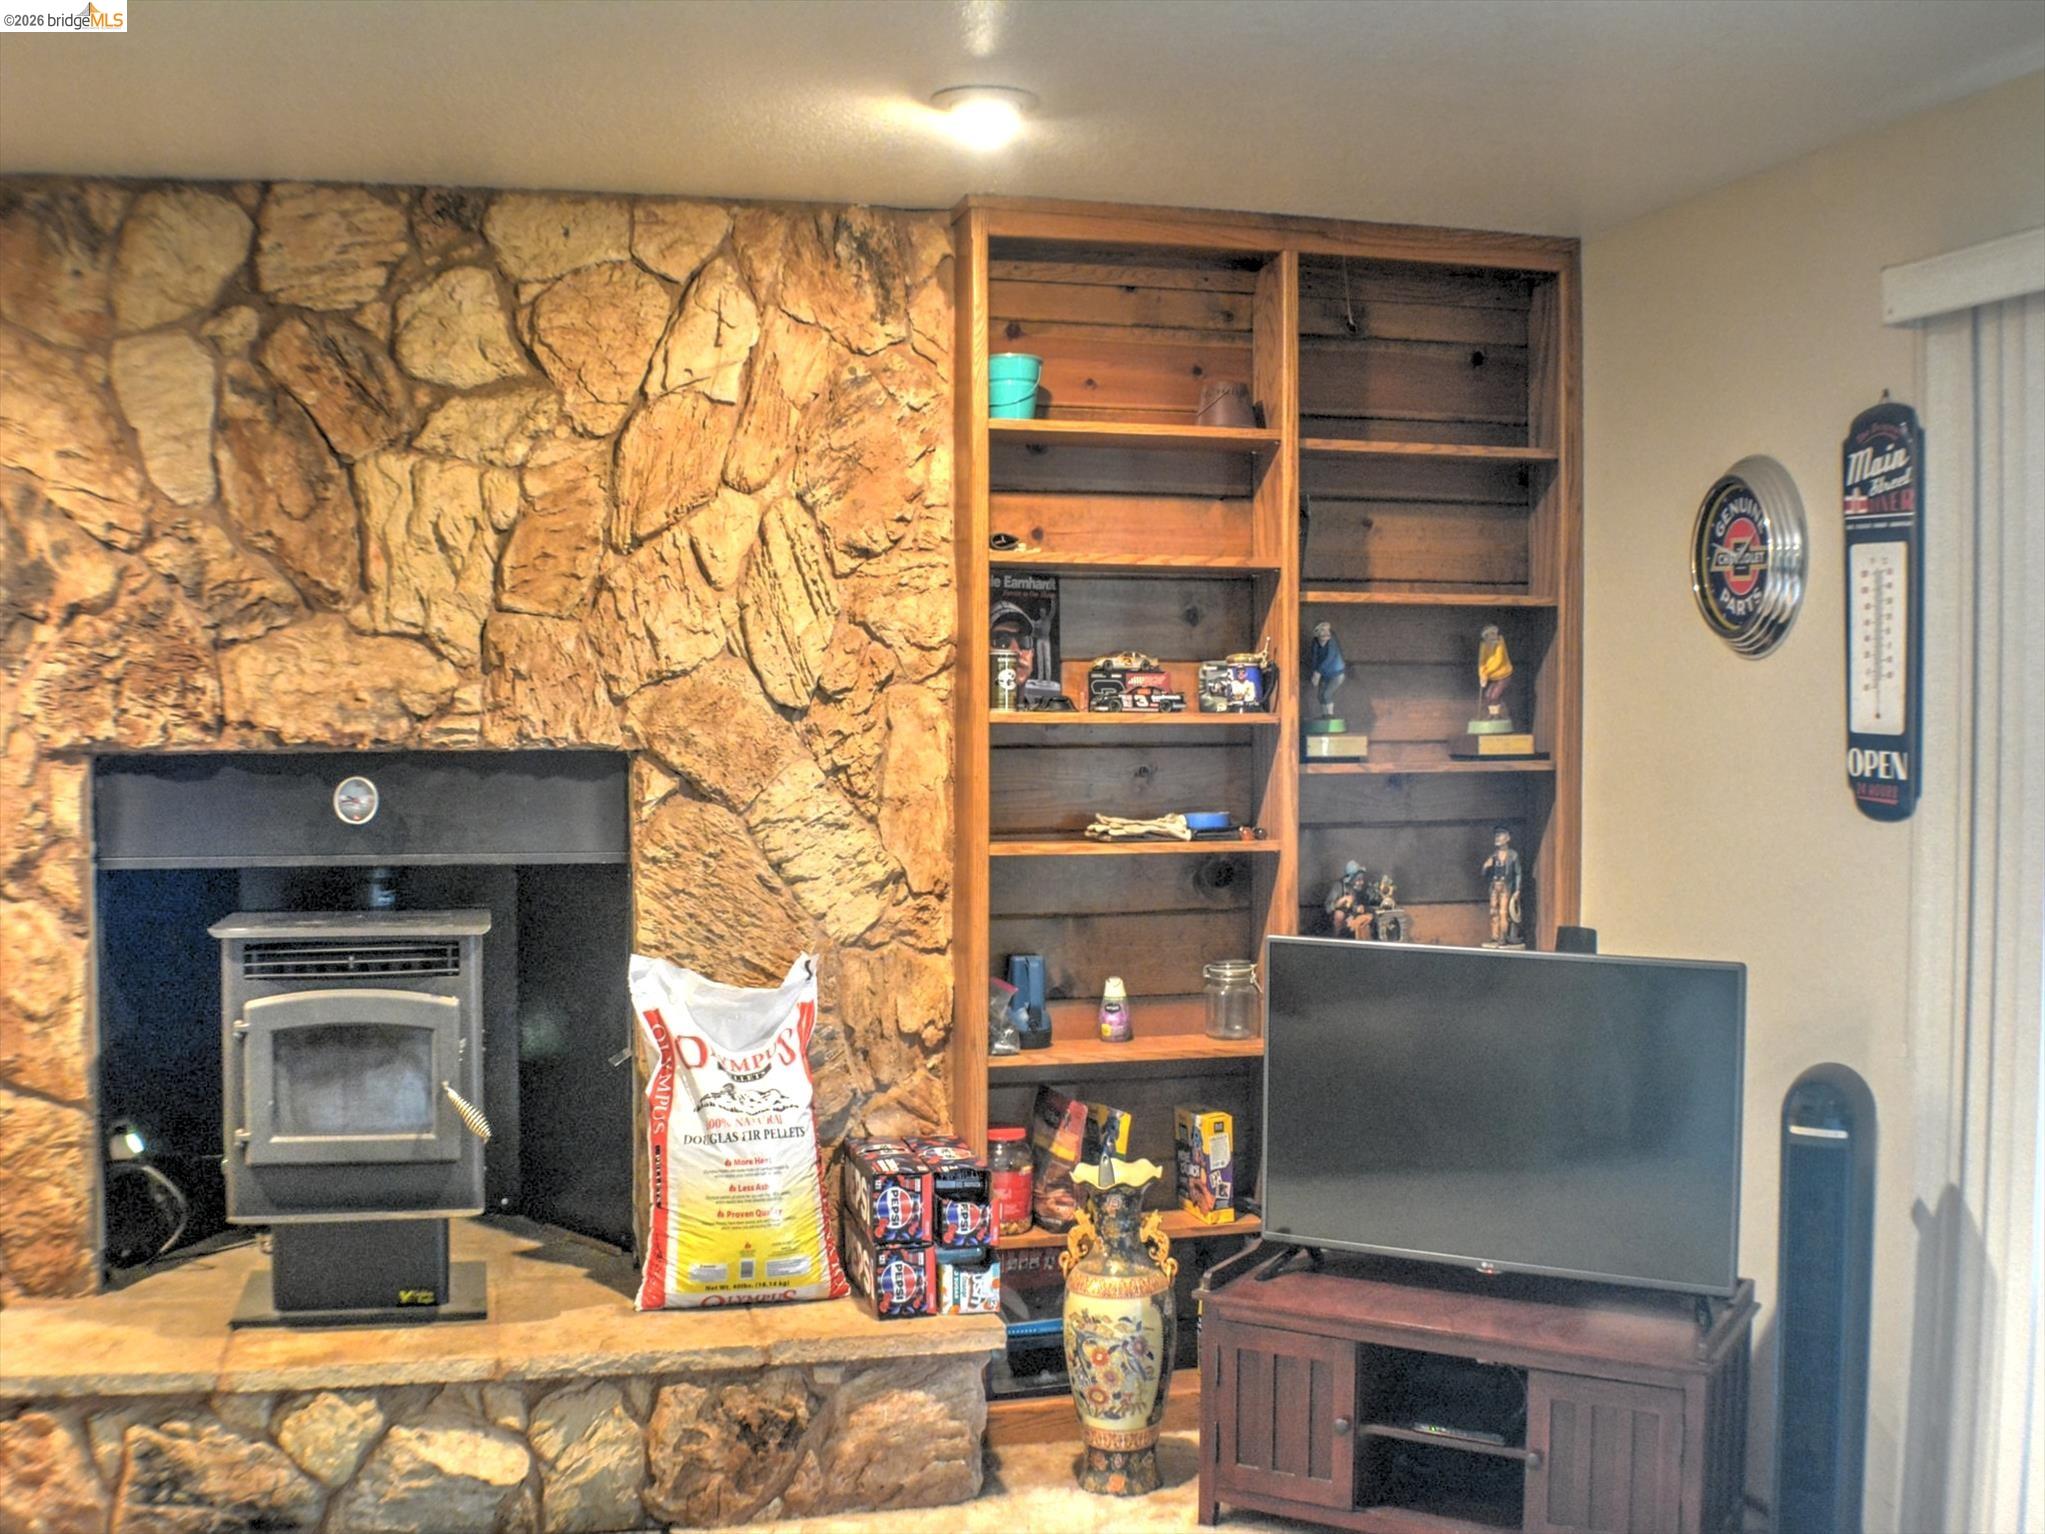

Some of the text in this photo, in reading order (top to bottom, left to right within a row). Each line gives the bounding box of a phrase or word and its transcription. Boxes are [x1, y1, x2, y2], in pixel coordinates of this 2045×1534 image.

[1846, 443, 1911, 487] Main
[1715, 498, 1765, 537] GENUINE
[1720, 587, 1762, 616] PARTS
[1134, 694, 1149, 708] 3
[1847, 747, 1909, 781] OPEN
[651, 1023, 672, 1136] OLYMPUS
[683, 1131, 739, 1145] DOUGLAS
[763, 1125, 806, 1141] PELLETS
[733, 1158, 753, 1167] More
[737, 1183, 755, 1193] Less
[726, 1207, 783, 1219] Proven Quay
[890, 1189, 900, 1226] PEPSI
[895, 1263, 904, 1300] PEPSI
